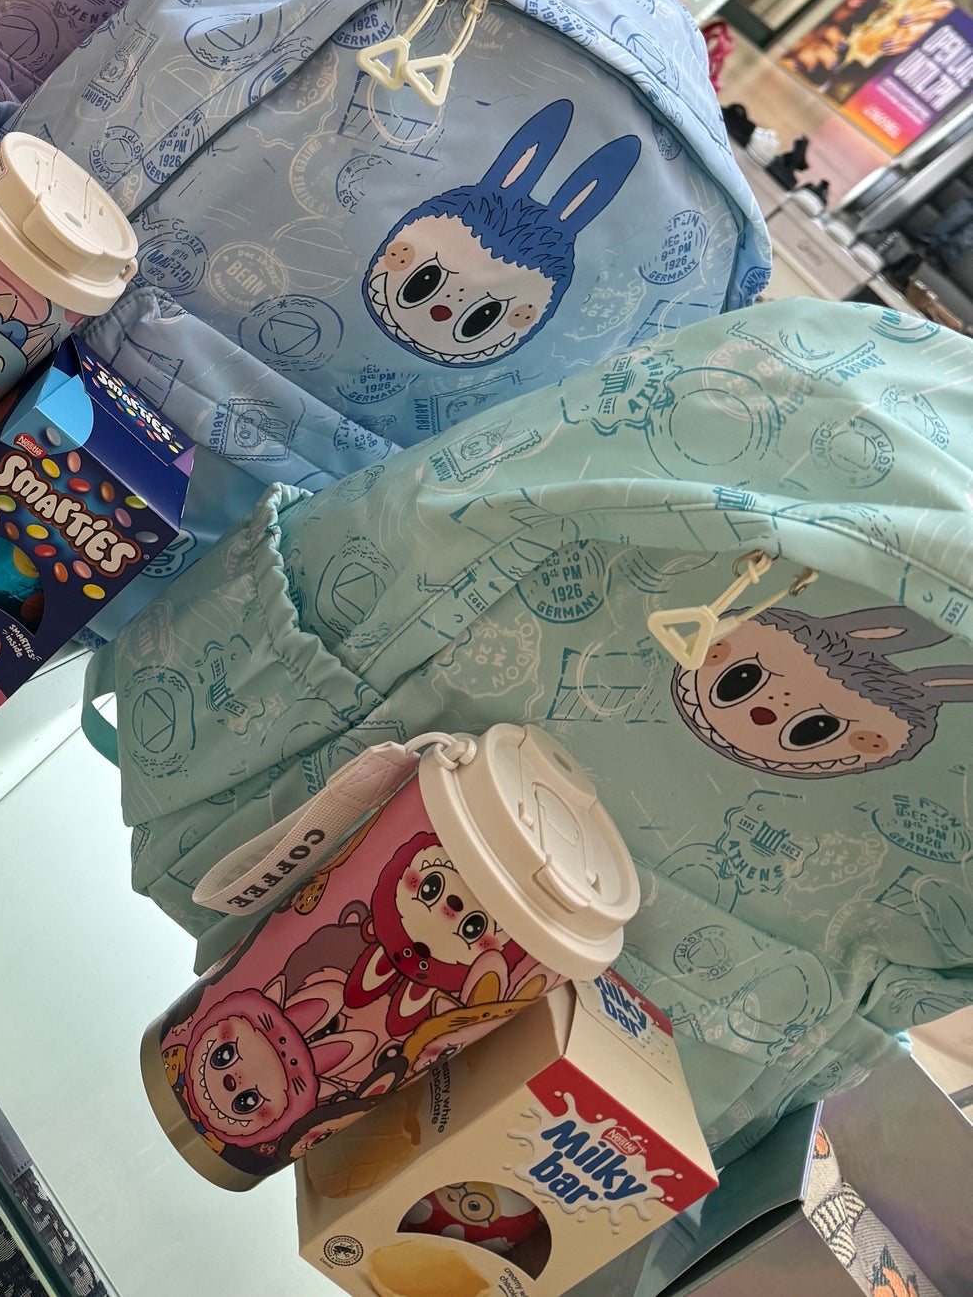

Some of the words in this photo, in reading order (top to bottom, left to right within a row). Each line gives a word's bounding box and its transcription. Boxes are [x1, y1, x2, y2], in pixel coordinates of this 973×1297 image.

[174, 139, 187, 153] PM
[159, 154, 182, 168] 1926
[678, 241, 692, 256] PM
[648, 259, 696, 283] GERMANY
[664, 255, 688, 272] 1926
[226, 260, 266, 296] BERN
[365, 382, 391, 395] 1926
[380, 372, 396, 382] PM
[348, 383, 402, 402] GERMANY
[562, 564, 583, 581] PM
[551, 583, 583, 603] 1926
[536, 591, 599, 620] GERMANY
[8, 624, 35, 659] SMARTIES
[227, 828, 325, 909] COFFEE
[728, 840, 784, 882] ATHENS
[430, 1067, 445, 1126] chocolate
[437, 1095, 452, 1134] white
[540, 1119, 649, 1201] Milky
[528, 1150, 599, 1205] bar
[504, 1266, 524, 1291] creamy
